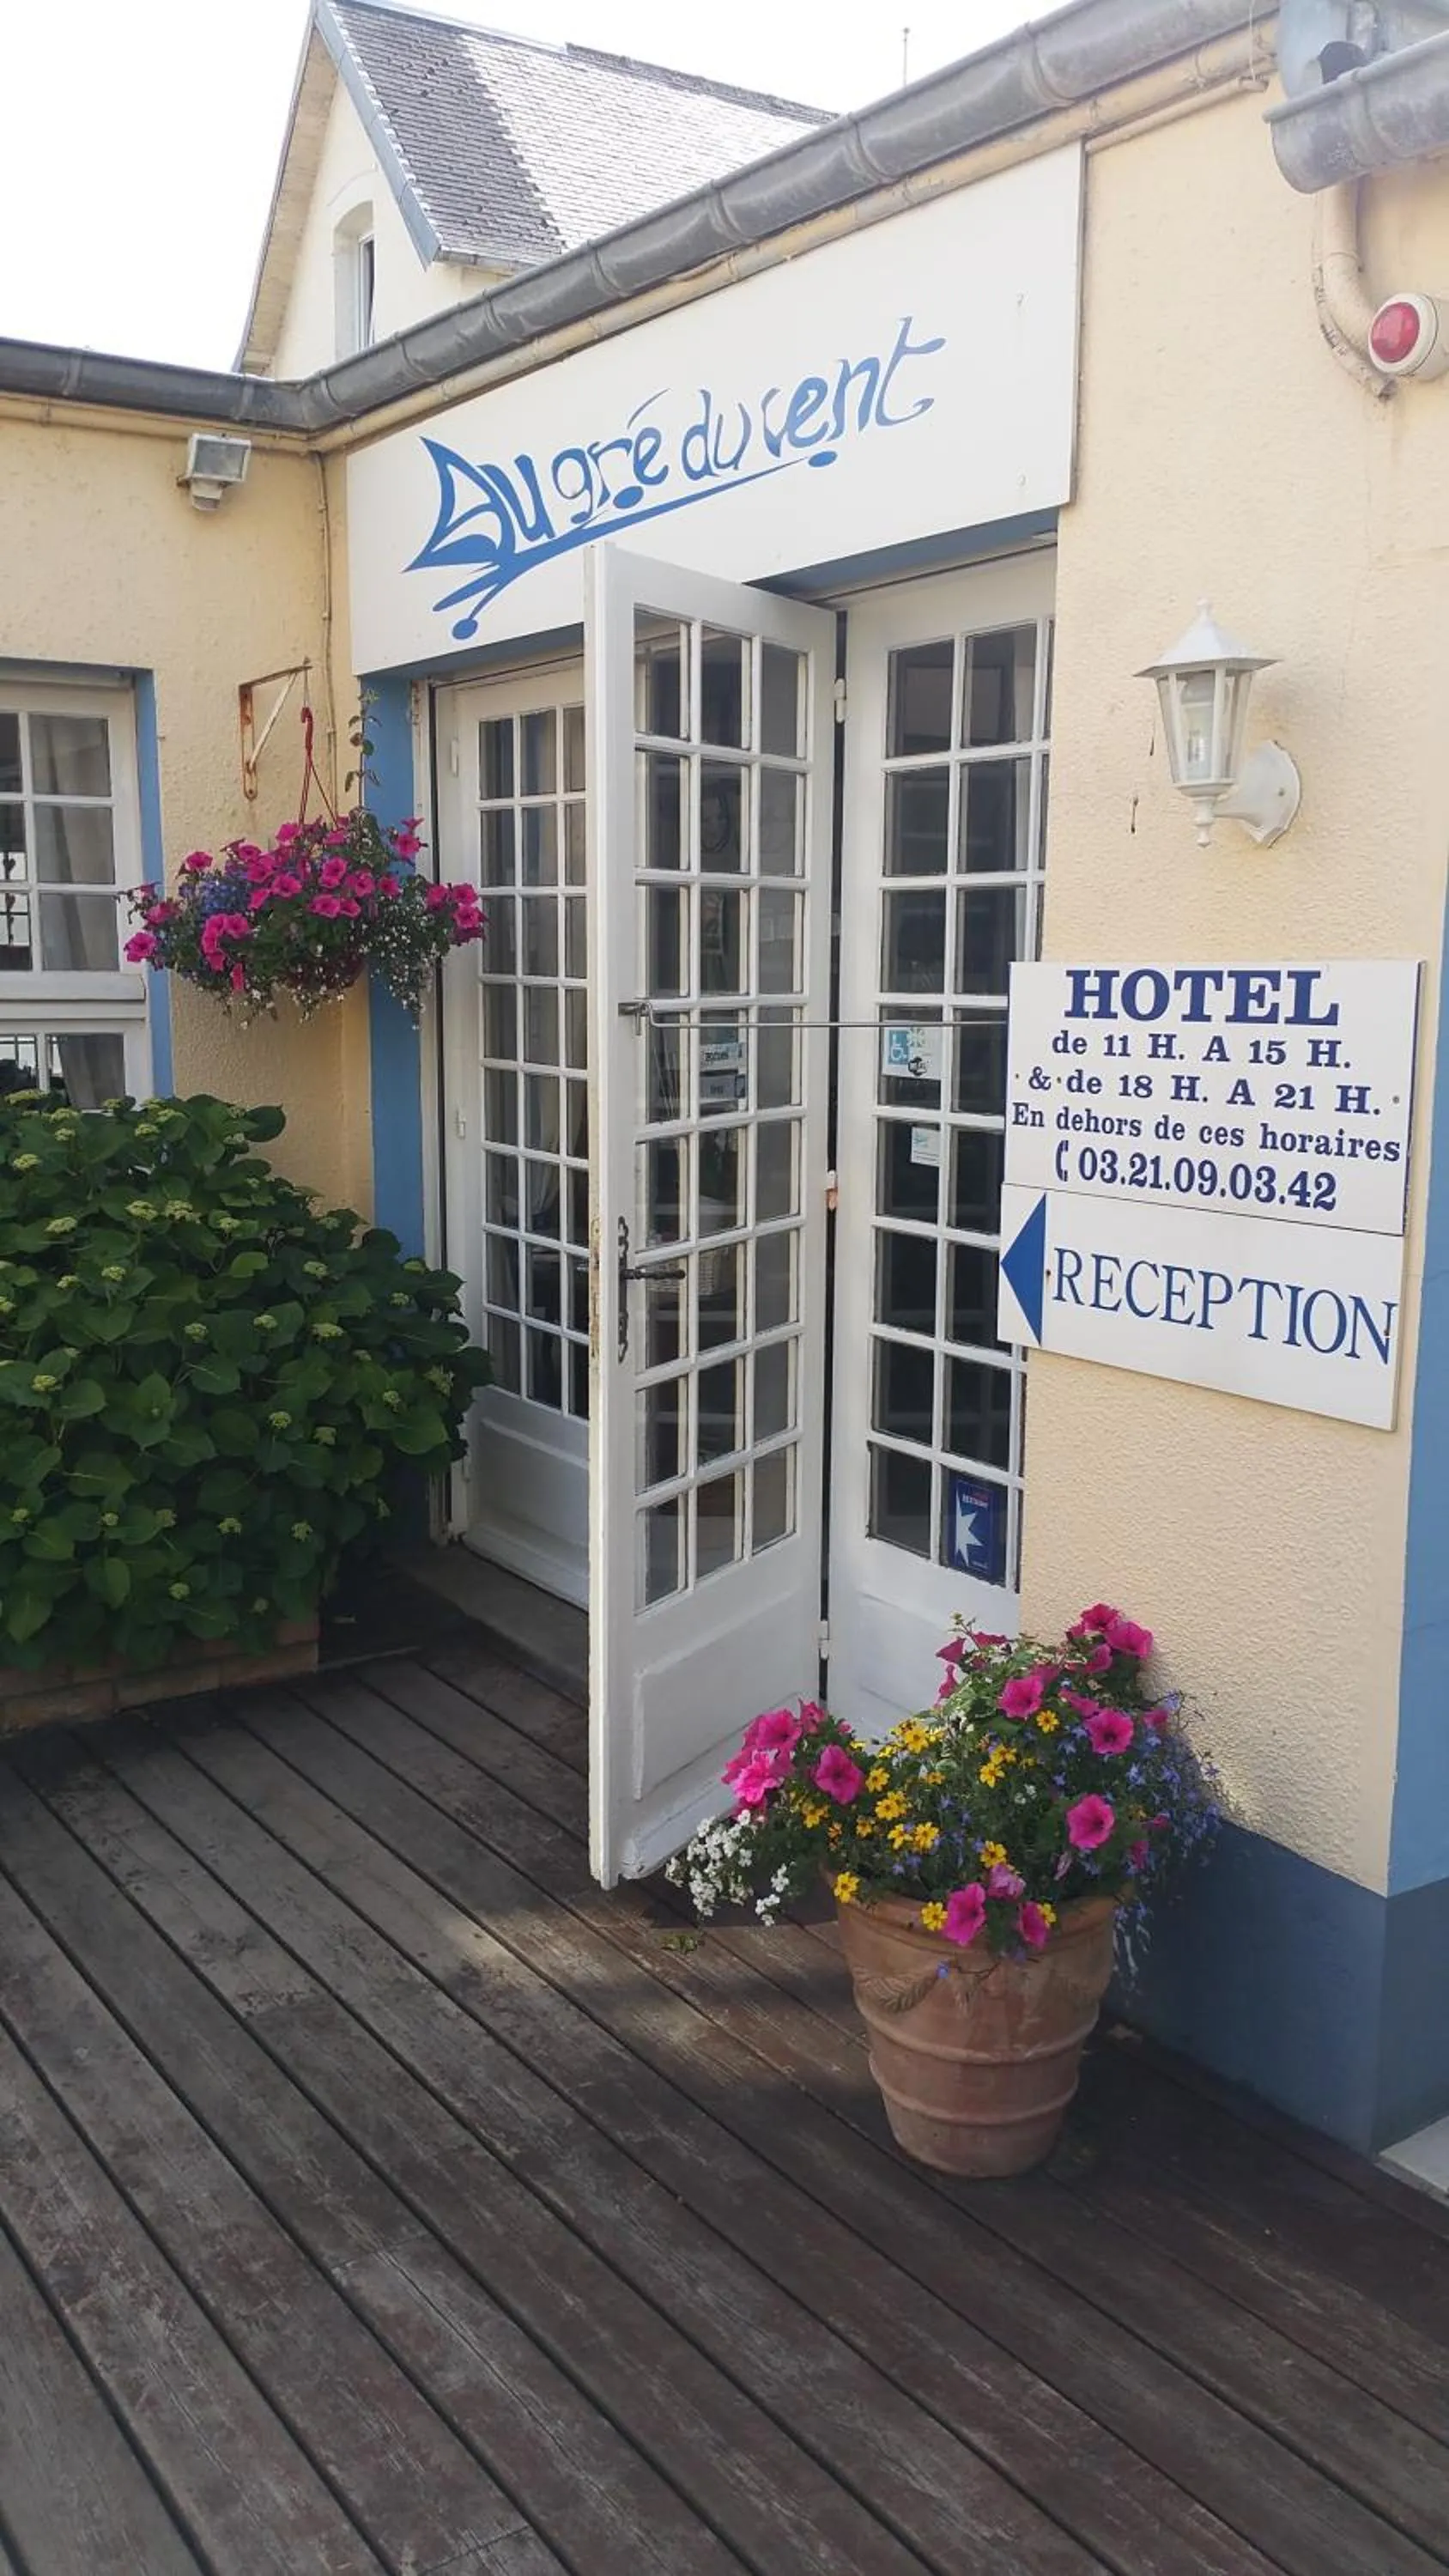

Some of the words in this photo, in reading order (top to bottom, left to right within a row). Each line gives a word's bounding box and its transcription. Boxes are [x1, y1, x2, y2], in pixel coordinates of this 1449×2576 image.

[551, 388, 669, 525] gré
[681, 388, 751, 482] du
[761, 316, 946, 459] vent
[1064, 969, 1339, 1026] HOTEL
[1052, 1030, 1088, 1056] de
[1103, 1034, 1131, 1057] 11
[1148, 1033, 1185, 1061] H.
[1202, 1035, 1231, 1062] A
[1248, 1040, 1287, 1066] 15
[1307, 1040, 1351, 1069] H.
[1028, 1066, 1052, 1091] &
[1066, 1068, 1102, 1095] de
[1119, 1074, 1153, 1098] 18
[1170, 1074, 1209, 1103] H.
[1226, 1078, 1256, 1107] A
[1274, 1084, 1315, 1110] 21
[1335, 1085, 1380, 1115] H.
[1012, 1102, 1045, 1127] En
[1056, 1106, 1142, 1138] dehors
[1154, 1115, 1185, 1141] de
[1199, 1125, 1245, 1147] ces
[1259, 1122, 1401, 1163] horaires
[1078, 1146, 1337, 1212] 03.21.09.03.42
[1052, 1248, 1397, 1365] RECEPTION
